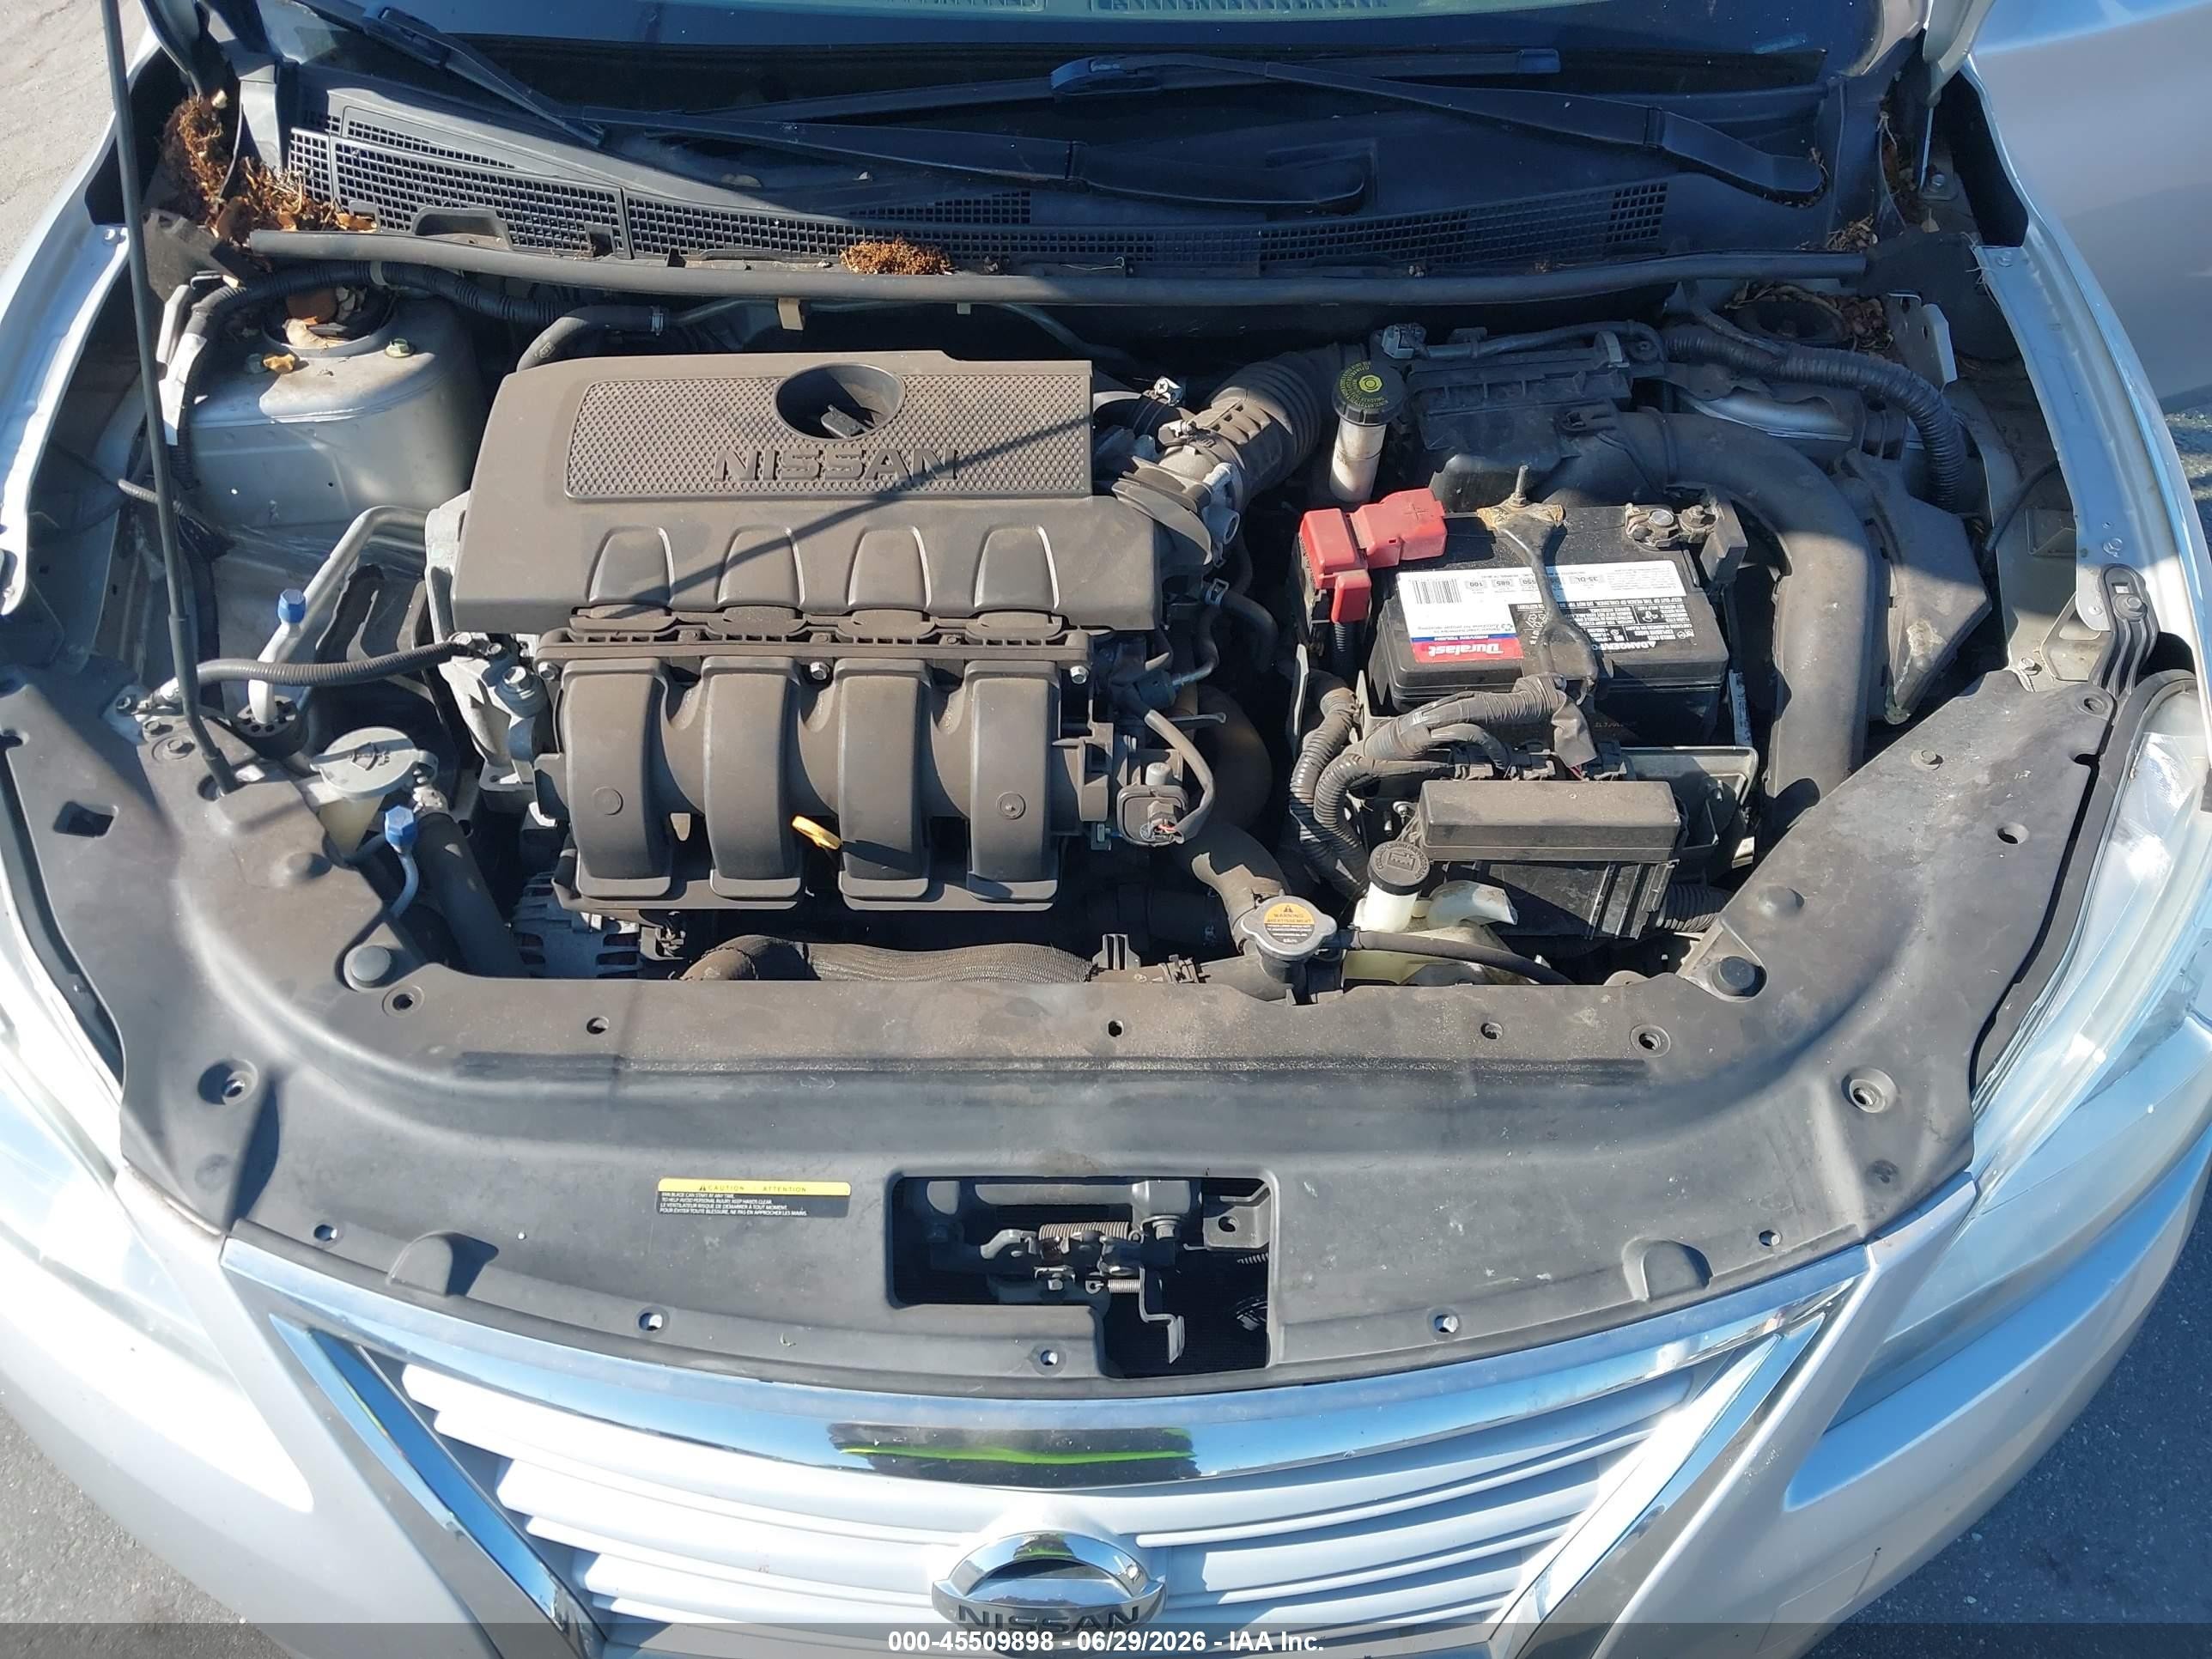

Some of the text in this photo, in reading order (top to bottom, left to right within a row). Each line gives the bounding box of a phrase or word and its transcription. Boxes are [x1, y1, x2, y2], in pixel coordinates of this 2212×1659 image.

[714, 448, 957, 481] NISSAN
[1429, 643, 1504, 657] Duralast
[958, 1604, 1139, 1633] NISSAN
